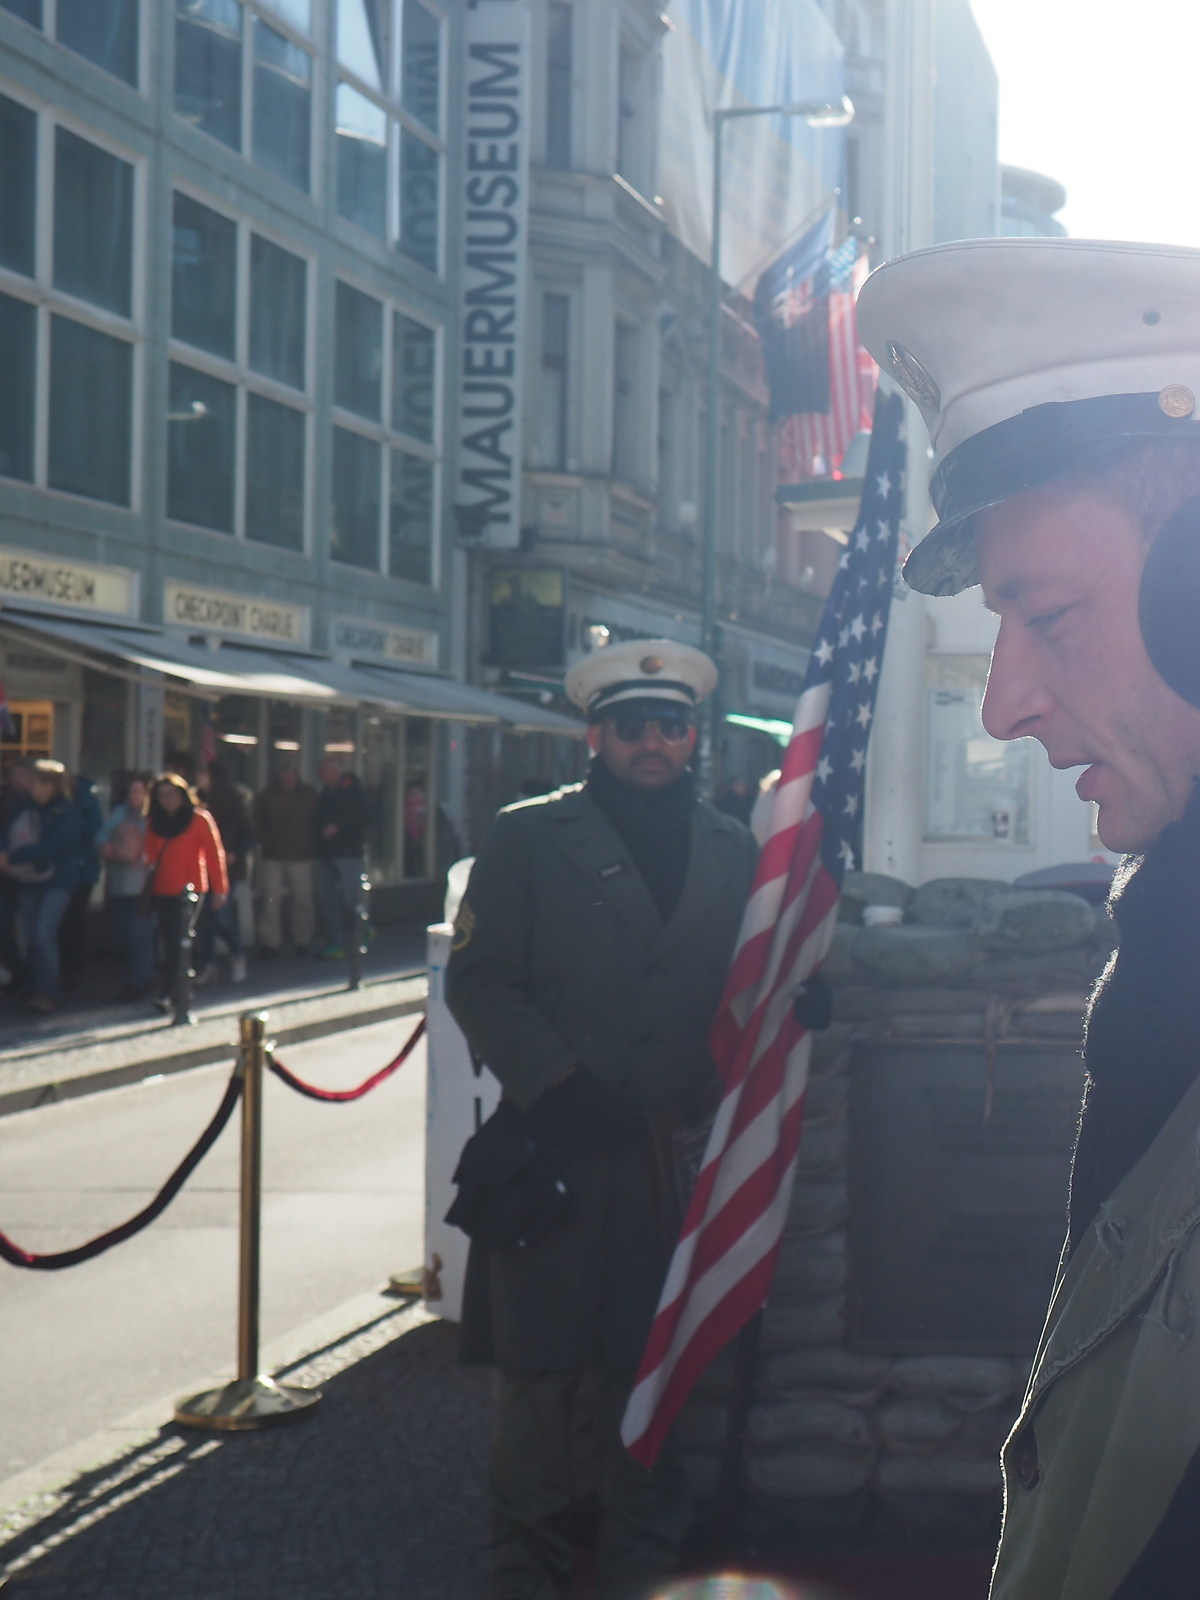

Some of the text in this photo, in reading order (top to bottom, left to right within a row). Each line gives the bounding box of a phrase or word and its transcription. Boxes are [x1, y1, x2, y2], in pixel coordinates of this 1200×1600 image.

[461, 42, 520, 524] MAUERMUSEUM
[175, 591, 294, 639] CHECKPOINT CHARLIE
